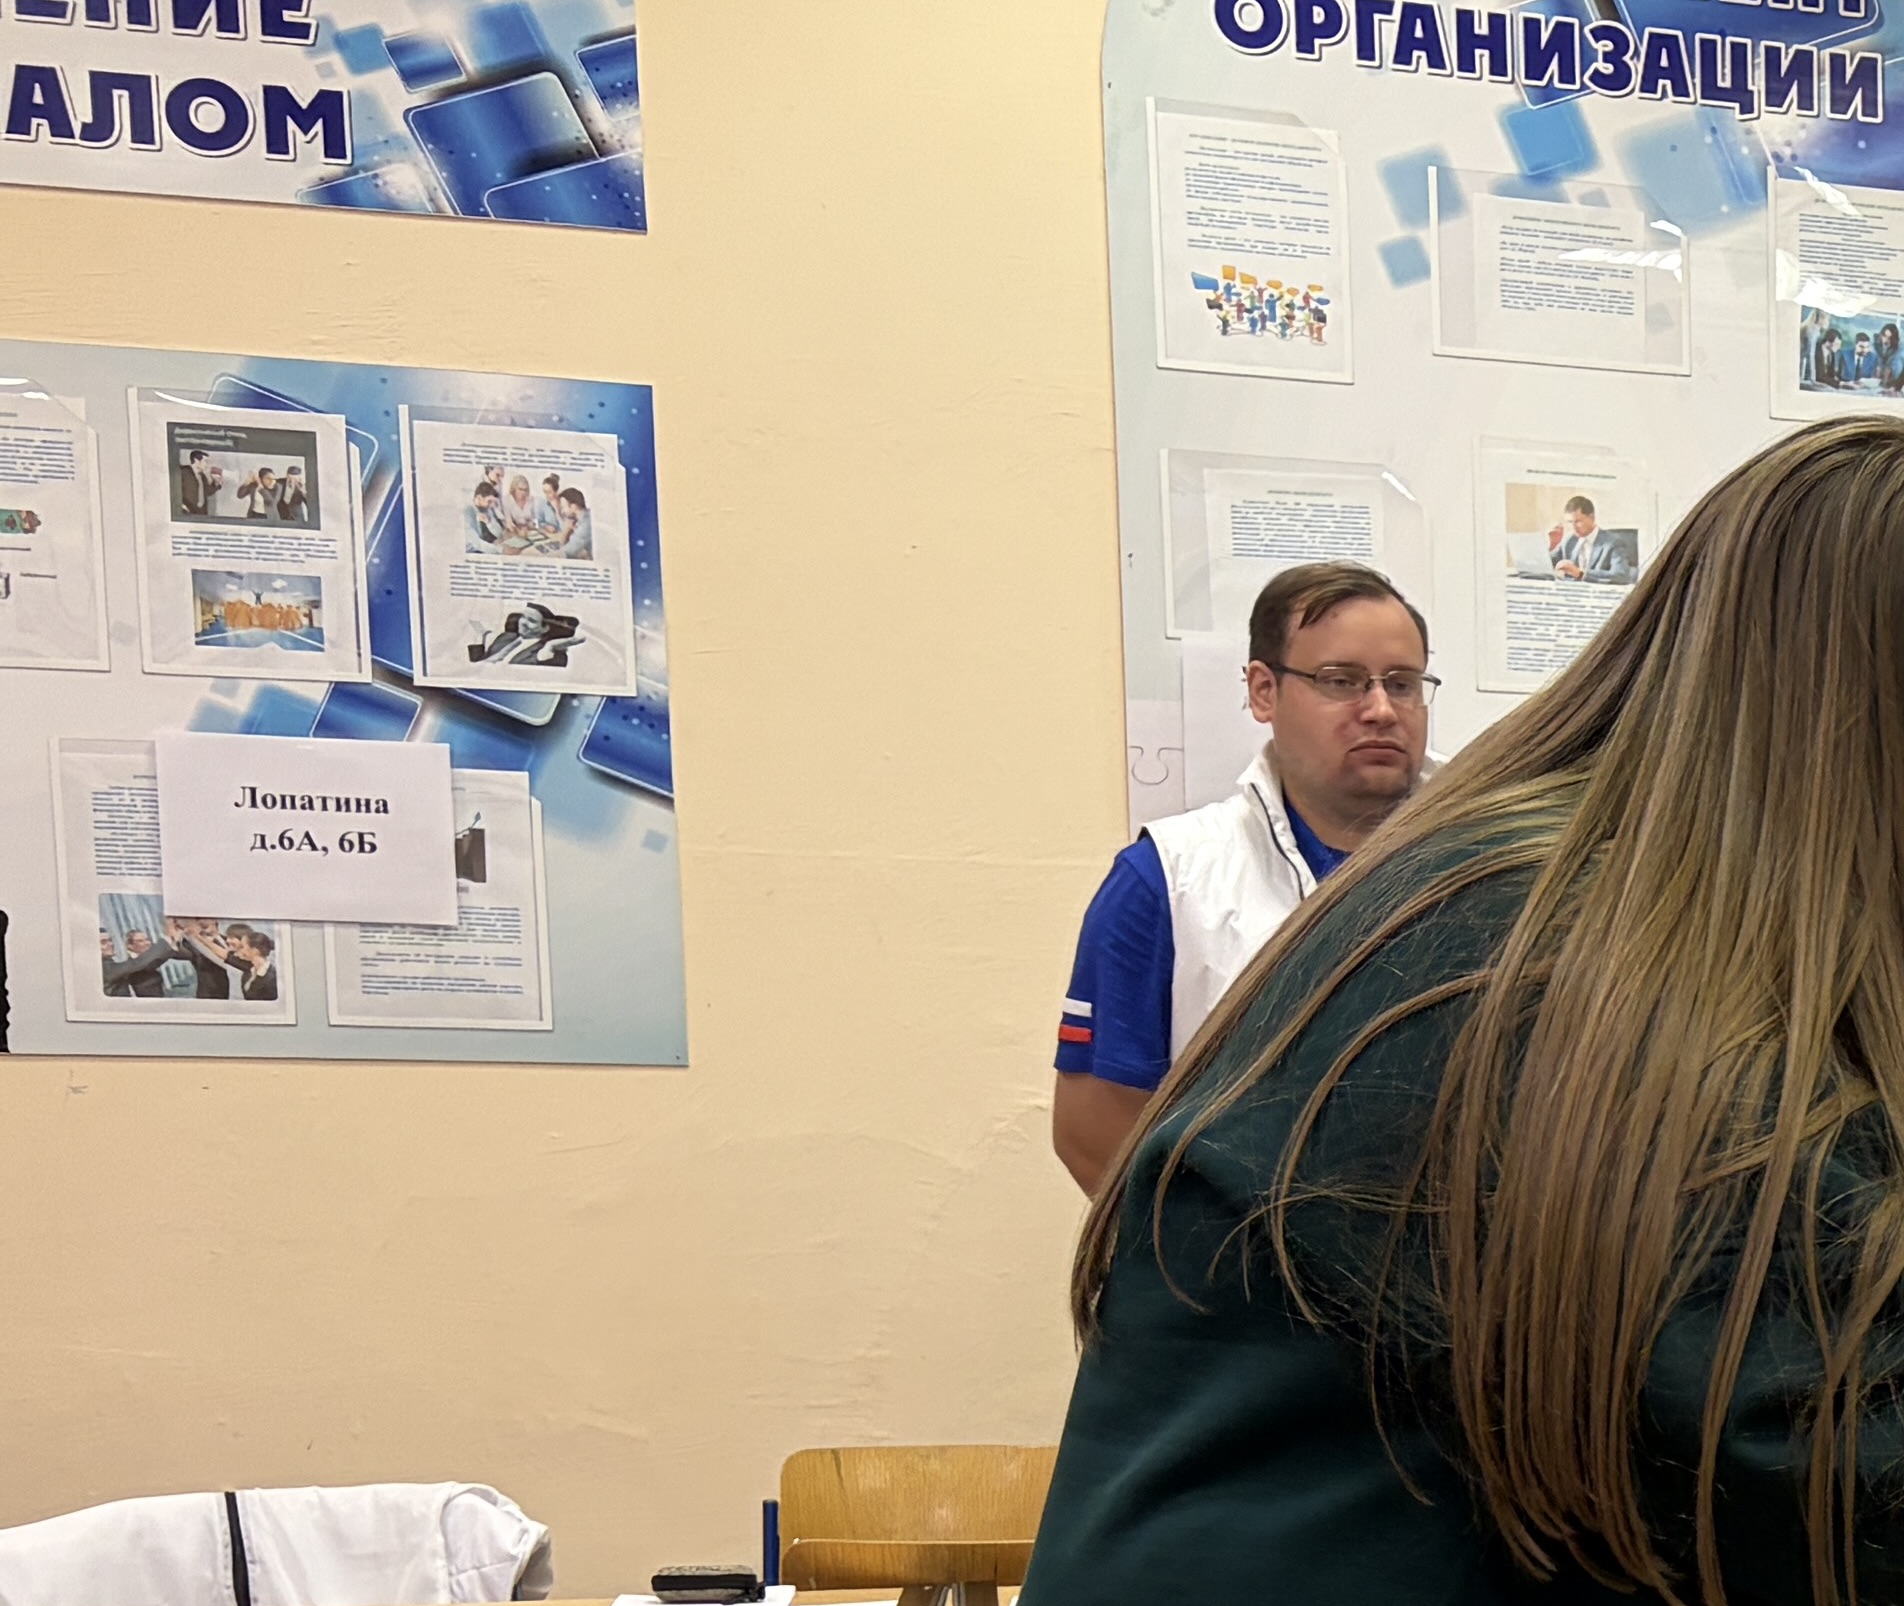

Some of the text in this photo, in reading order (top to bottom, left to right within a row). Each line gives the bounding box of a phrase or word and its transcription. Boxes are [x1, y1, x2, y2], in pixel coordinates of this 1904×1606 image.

[1214, 0, 1884, 122] ОРГАНИЗАЦИИ
[233, 785, 391, 817] Лопатина
[249, 829, 378, 857] д.6А, 6Б
